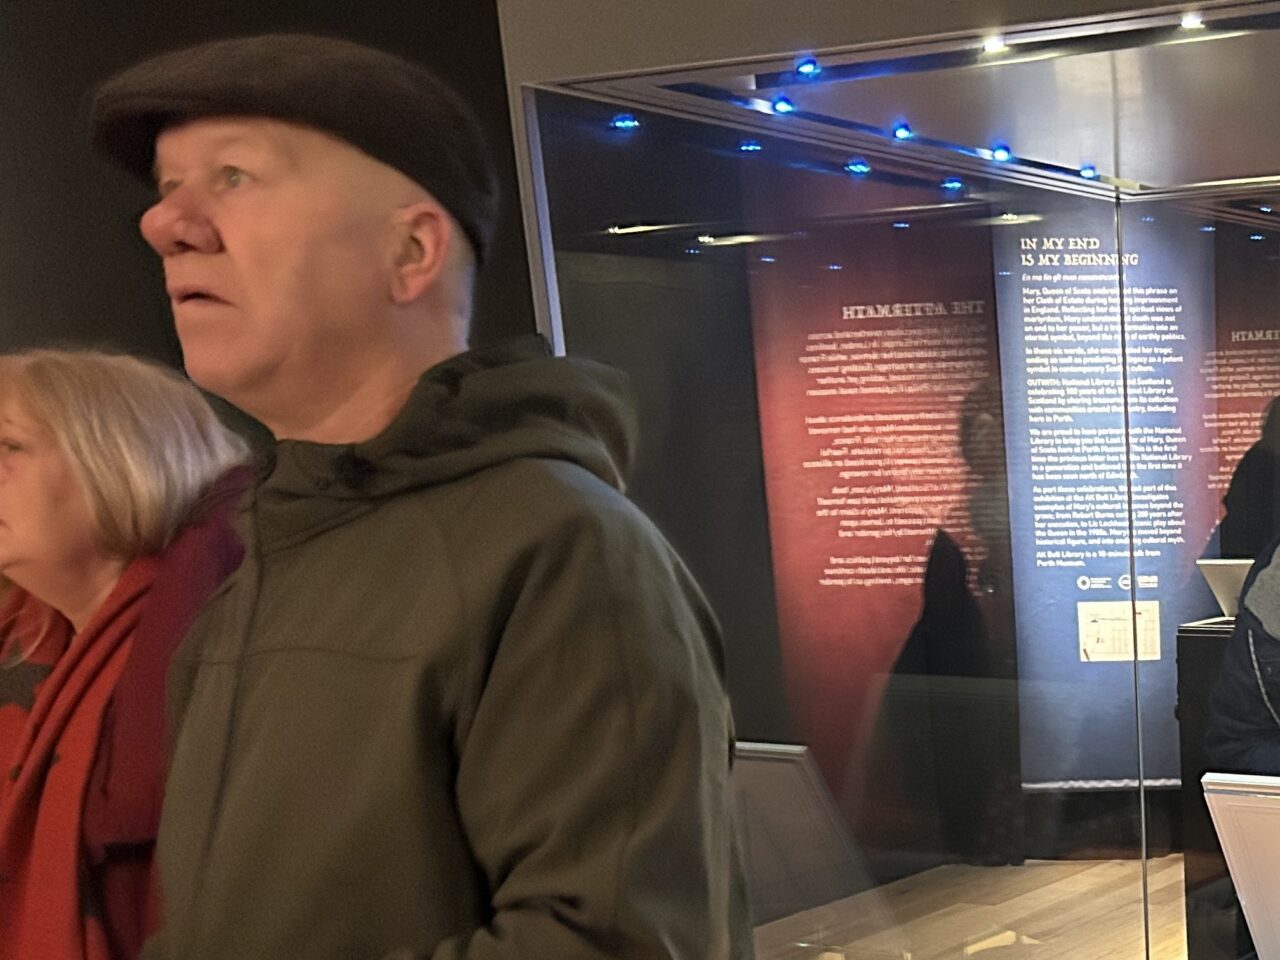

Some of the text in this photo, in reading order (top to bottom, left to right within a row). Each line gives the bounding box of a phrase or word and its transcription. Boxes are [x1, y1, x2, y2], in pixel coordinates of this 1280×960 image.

[1021, 238, 1100, 249] IN MY END
[1021, 253, 1138, 266] IS MY BEGINNING
